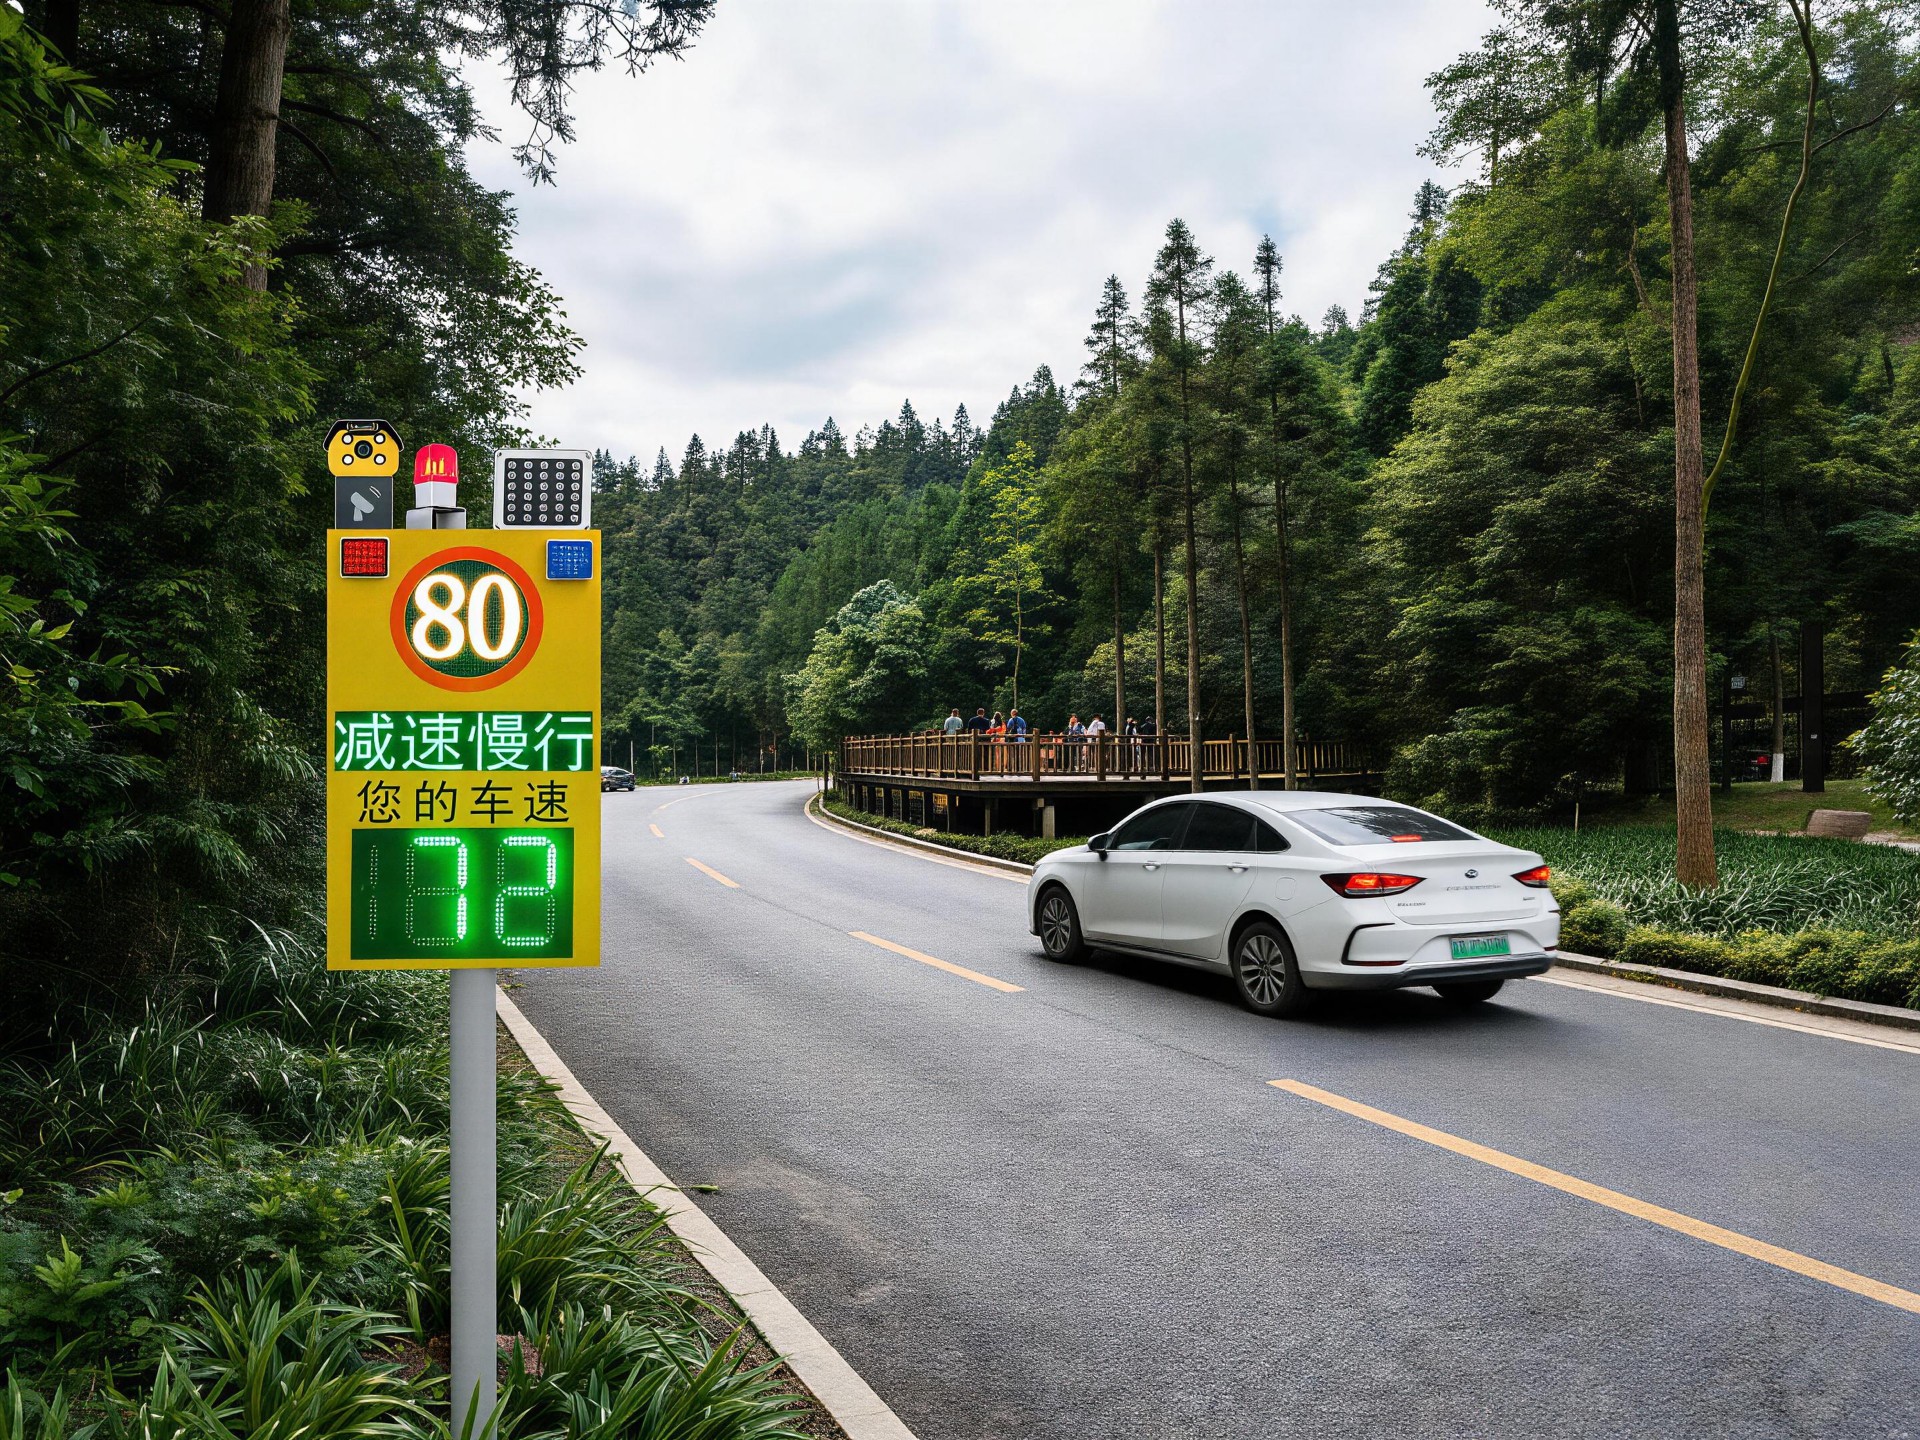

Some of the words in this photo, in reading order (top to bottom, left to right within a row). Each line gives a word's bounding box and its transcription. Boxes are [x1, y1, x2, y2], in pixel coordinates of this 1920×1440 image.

[412, 573, 521, 660] 80
[335, 712, 593, 771] 减速慢行
[357, 779, 570, 823] 您的车速
[413, 836, 557, 946] 72
